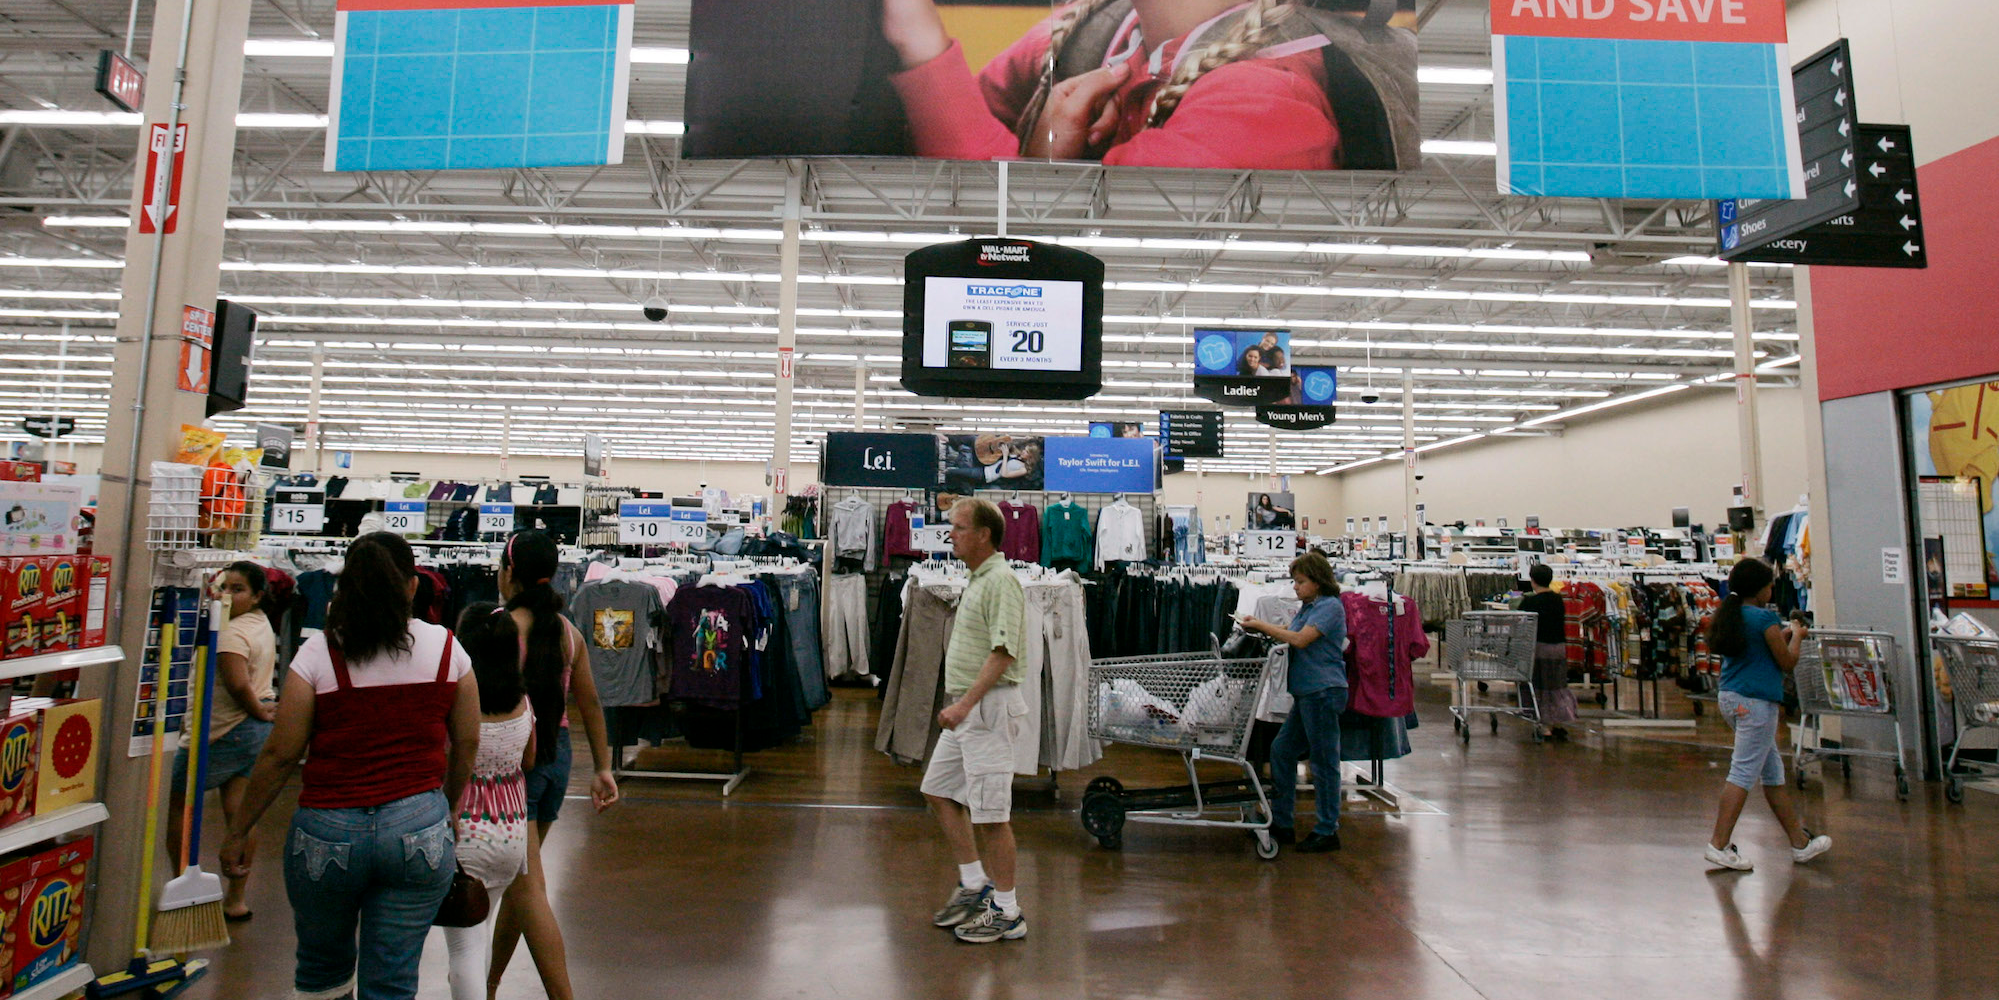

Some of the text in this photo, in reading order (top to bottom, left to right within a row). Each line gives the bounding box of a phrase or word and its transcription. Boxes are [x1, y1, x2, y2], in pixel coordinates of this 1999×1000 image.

[1511, 0, 1746, 24] AND SAVE
[156, 134, 180, 147] FIE
[1741, 219, 1766, 236] Shoes
[970, 286, 1039, 297] TRACFONE
[184, 321, 213, 337] CENTER
[1267, 411, 1325, 422] Young Men's
[1058, 458, 1083, 467] Taylor
[1085, 458, 1107, 467] Swift
[1108, 458, 1120, 467] for
[19, 568, 41, 597] RITZ
[53, 566, 74, 594] RITZ
[2, 733, 30, 781] RITZ
[32, 885, 73, 944] RITZ
